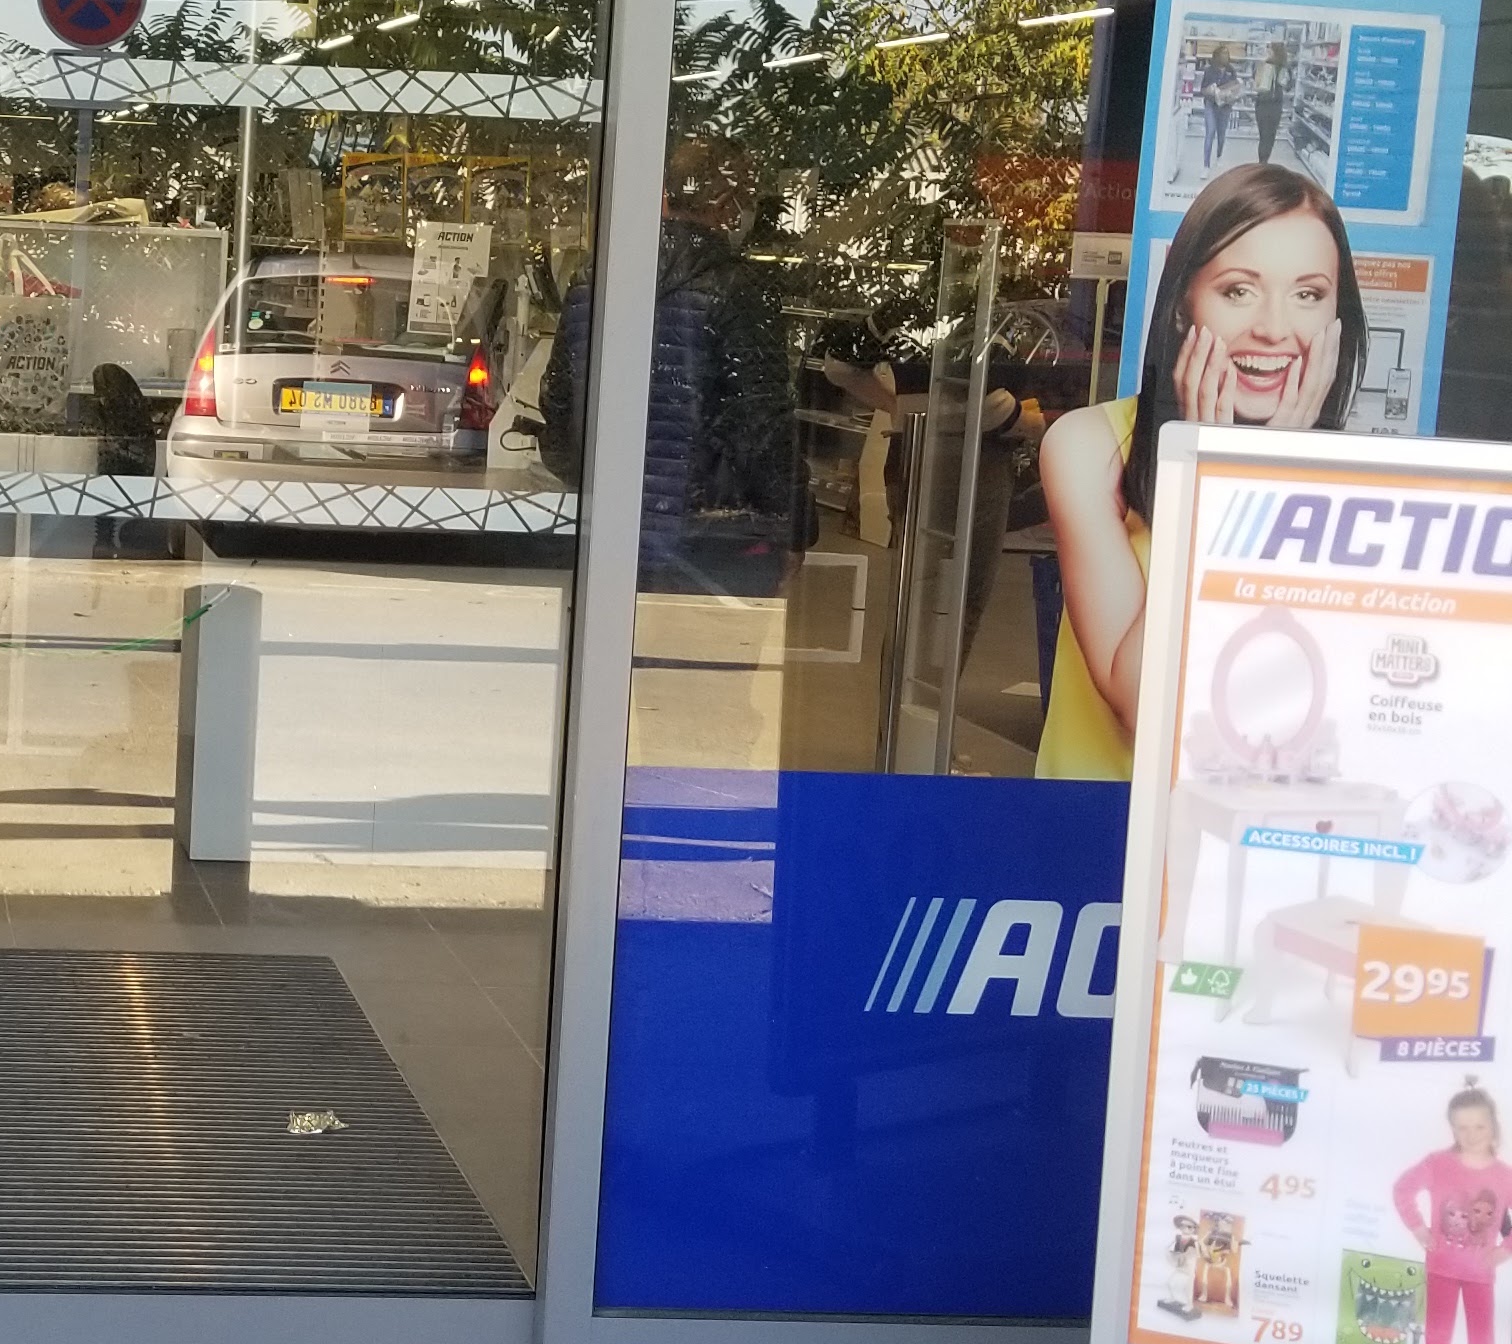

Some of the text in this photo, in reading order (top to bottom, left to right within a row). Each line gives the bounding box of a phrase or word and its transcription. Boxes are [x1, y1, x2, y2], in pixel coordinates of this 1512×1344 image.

[438, 232, 474, 243] ACTION
[6, 356, 56, 370] ACTION
[1234, 578, 1457, 615] la semaine d'Action
[1391, 638, 1420, 655] MINI
[1370, 694, 1443, 712] Coiffeuse
[1369, 711, 1422, 725] en bois
[1248, 830, 1360, 854] ACCESSOIRES
[1364, 843, 1407, 860] INCL.
[1397, 1037, 1482, 1057] 8 PIÈCES
[1171, 1138, 1228, 1154] Feutres et
[1170, 1149, 1229, 1165] marqueurs
[1169, 1171, 1194, 1183] dans
[1197, 1176, 1210, 1184] un
[1179, 1161, 1214, 1175] pointe
[1217, 1166, 1239, 1178] fine
[1255, 1270, 1310, 1286] Squelette
